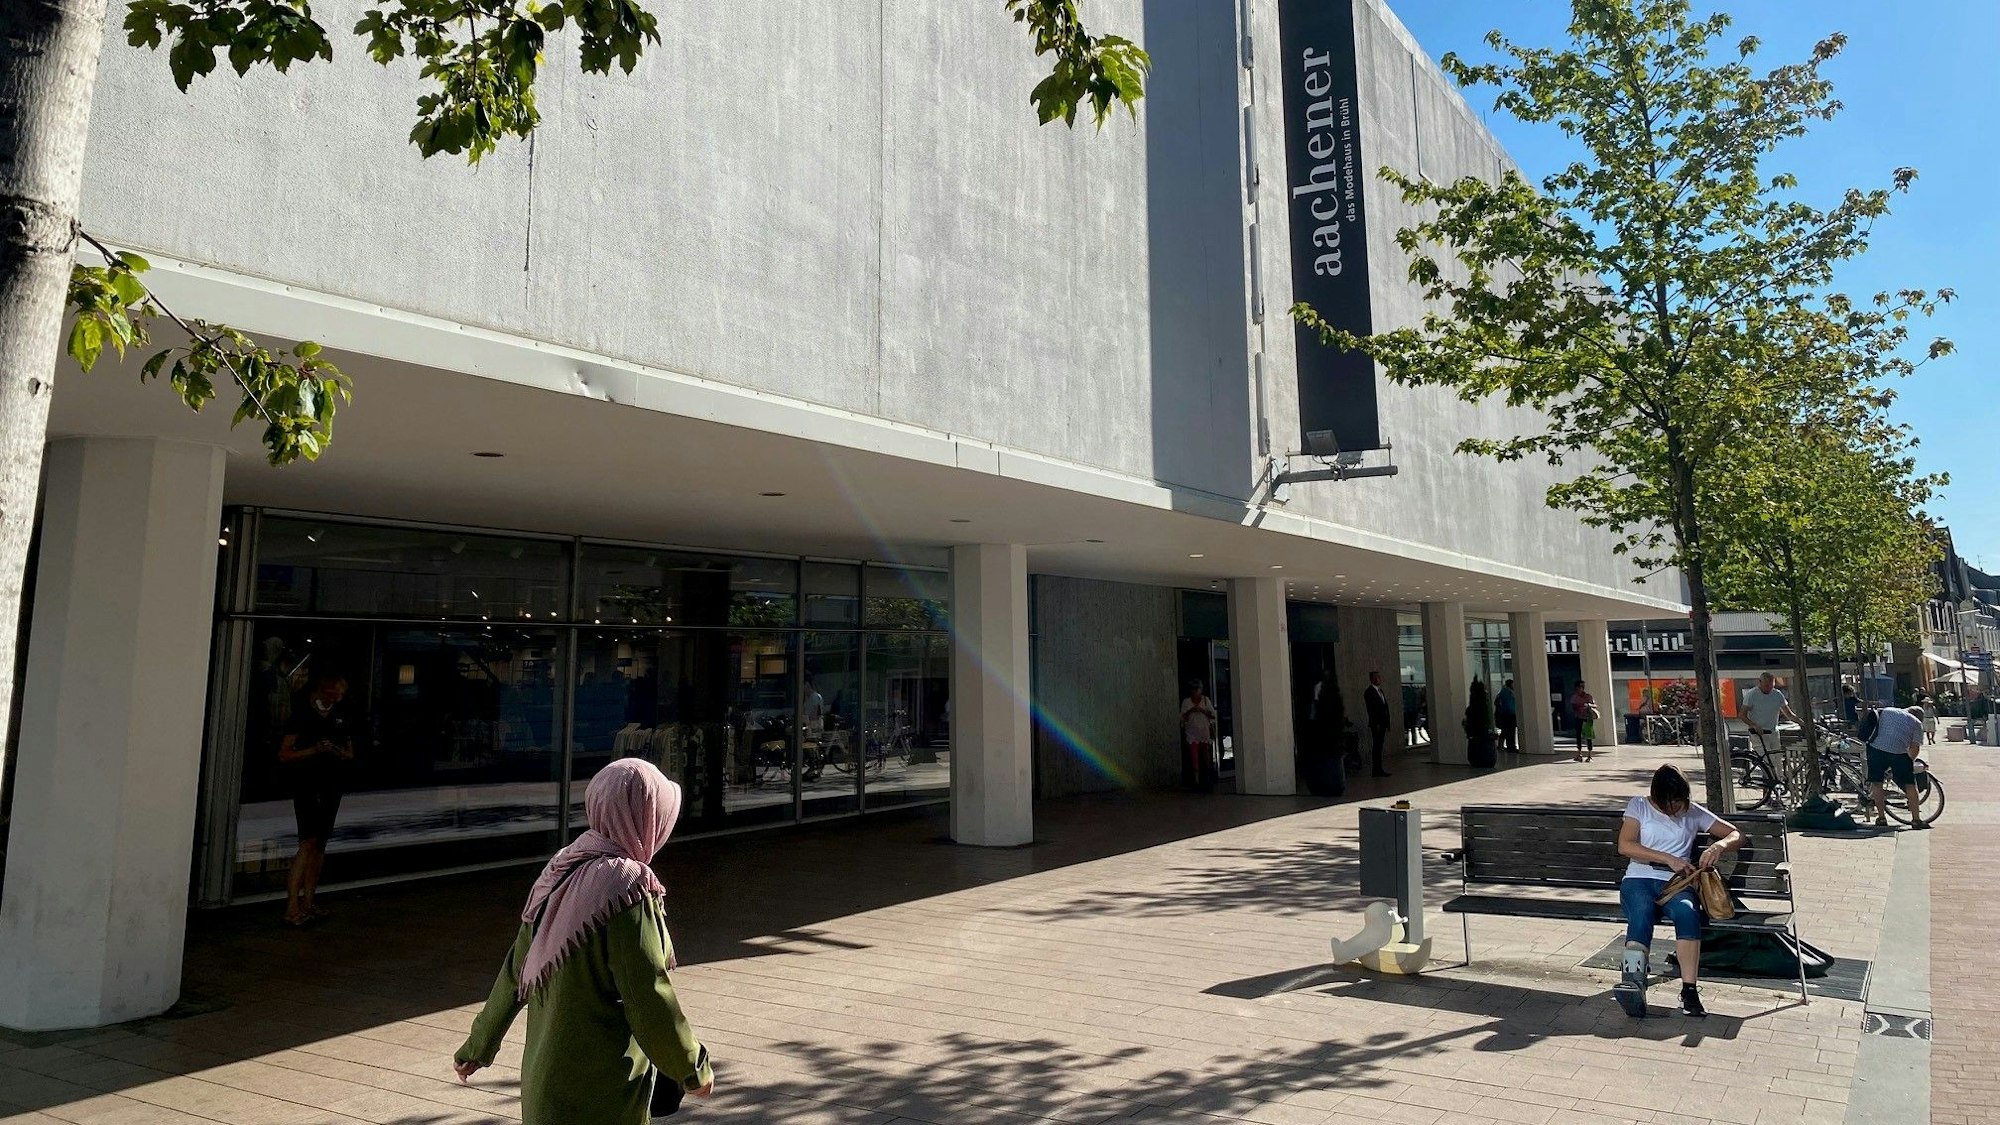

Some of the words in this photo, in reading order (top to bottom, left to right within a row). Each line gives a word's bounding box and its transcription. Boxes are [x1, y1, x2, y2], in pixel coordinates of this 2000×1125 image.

[1340, 97, 1350, 127] Brühl
[1341, 130, 1351, 140] in
[1293, 47, 1343, 277] aachener
[1343, 143, 1355, 200] Modehaus
[1345, 203, 1356, 222] das
